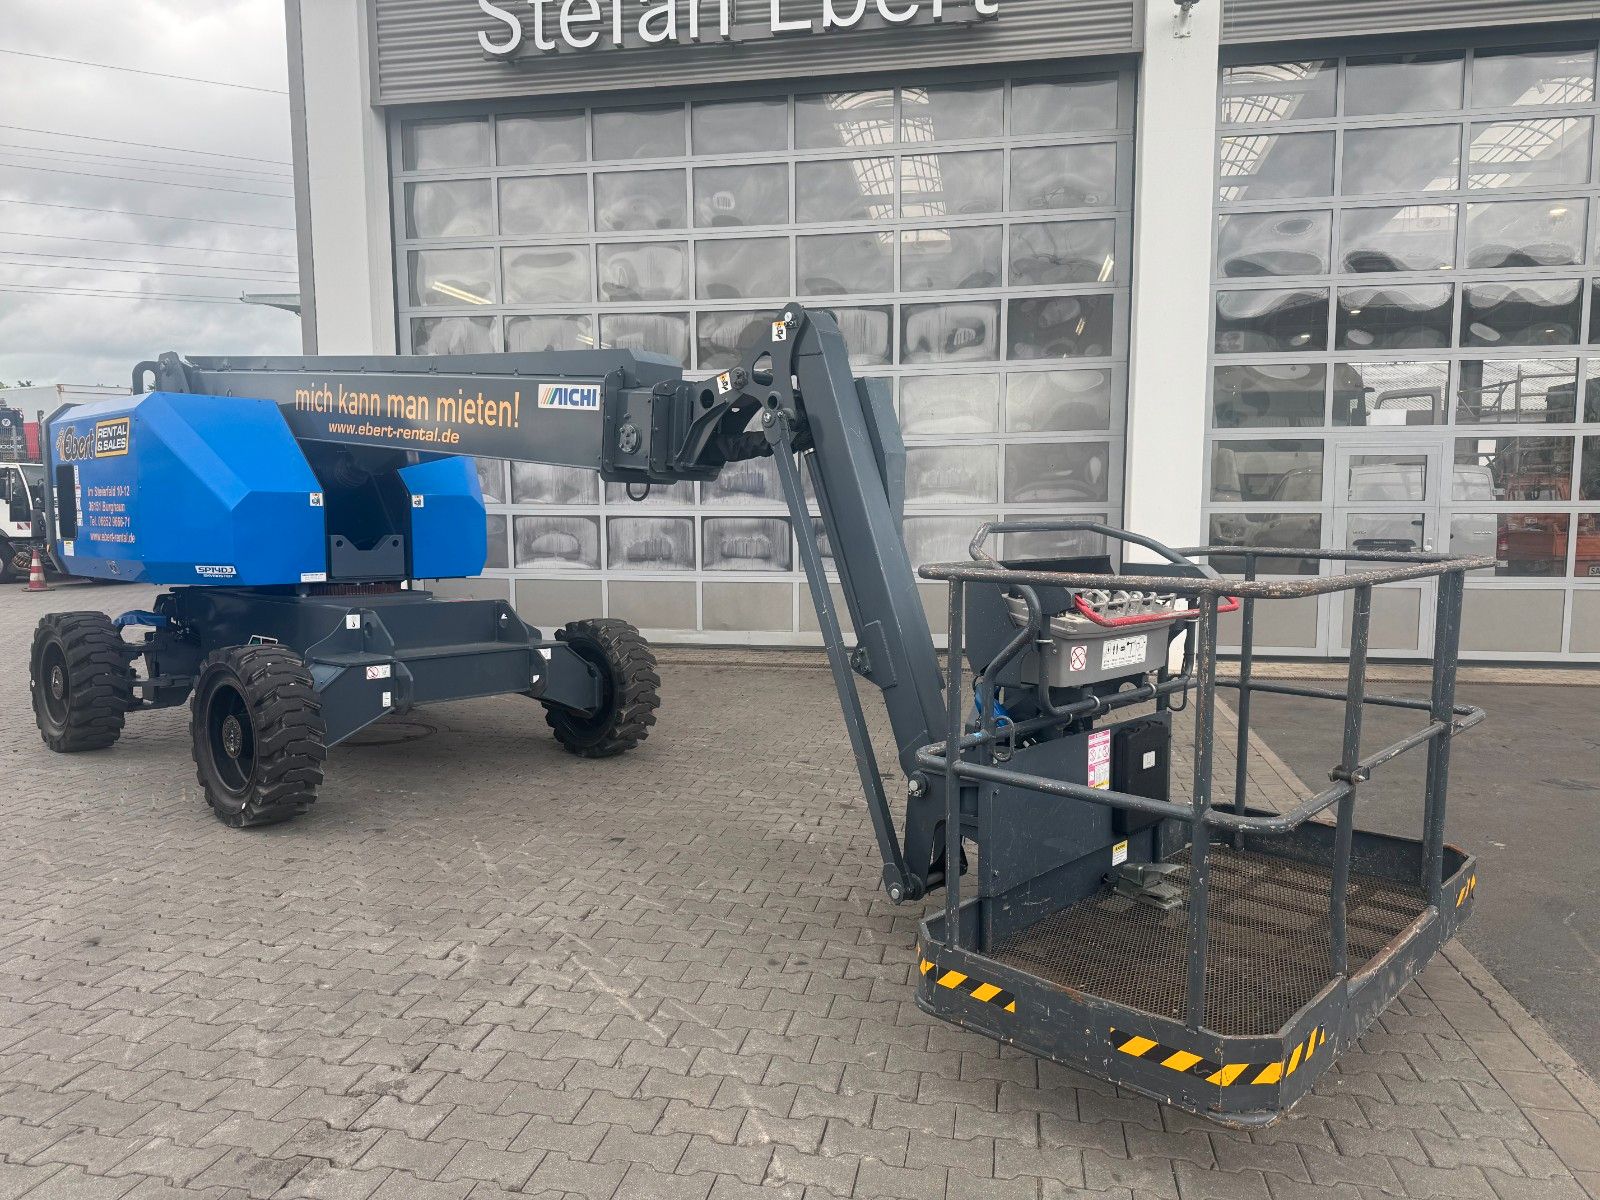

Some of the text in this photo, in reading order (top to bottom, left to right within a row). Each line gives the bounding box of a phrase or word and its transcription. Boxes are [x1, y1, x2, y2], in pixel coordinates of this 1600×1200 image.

[295, 382, 520, 429] mich kann man mieten!
[549, 387, 597, 407] AICHI
[97, 424, 127, 440] RENTAL
[328, 421, 460, 445] www.ebert-rental.de
[104, 437, 127, 451] SALES
